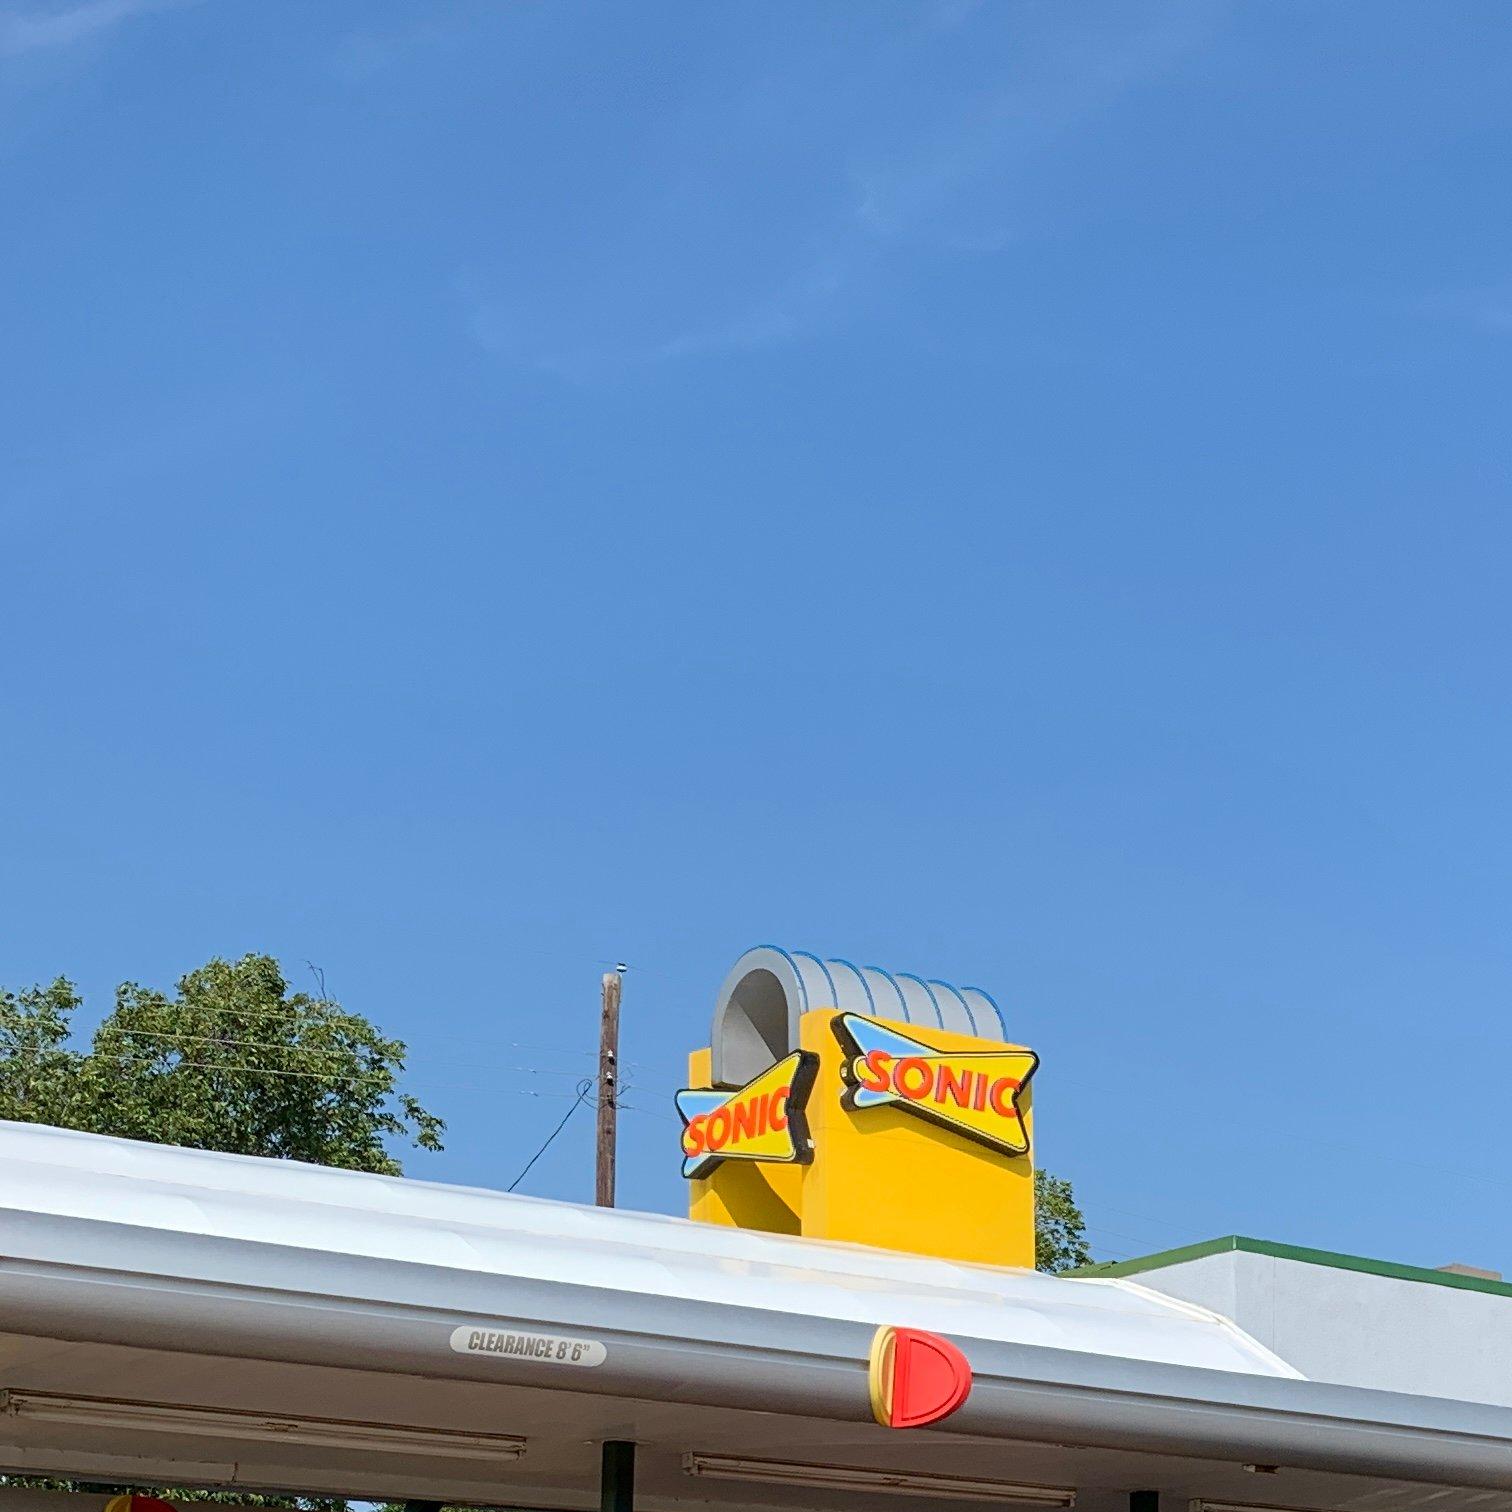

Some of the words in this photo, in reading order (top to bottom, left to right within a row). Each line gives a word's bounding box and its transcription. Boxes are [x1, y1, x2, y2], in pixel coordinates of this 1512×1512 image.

[860, 1050, 1022, 1118] SONIC
[684, 1087, 791, 1157] SONIC
[468, 1331, 554, 1358] CLEARANCE
